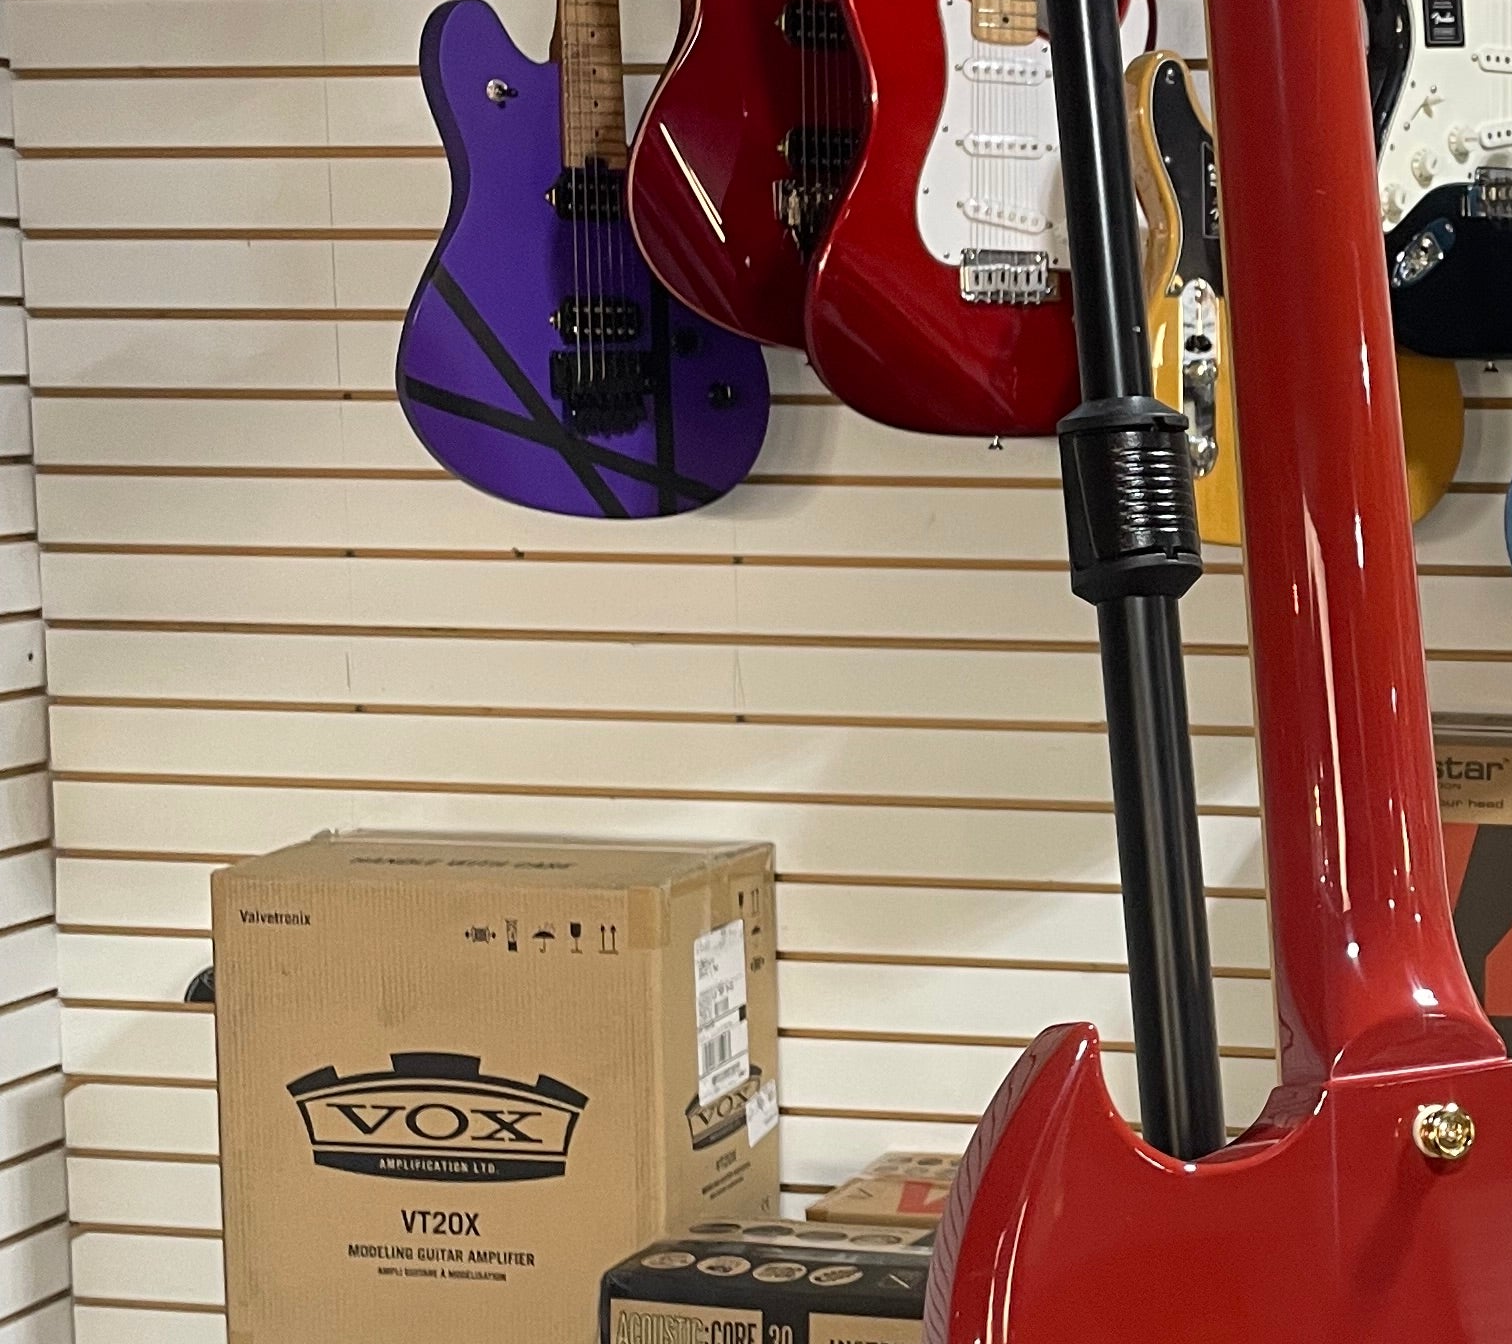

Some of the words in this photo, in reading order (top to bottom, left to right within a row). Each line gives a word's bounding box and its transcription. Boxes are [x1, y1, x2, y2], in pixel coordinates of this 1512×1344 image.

[239, 909, 311, 927] Valvetronix
[326, 1102, 543, 1144] VOX
[379, 1158, 469, 1174] AMPLIFICATION
[401, 1209, 481, 1237] VT20X
[348, 1244, 413, 1261] MODELING
[417, 1246, 464, 1264] GUITAR
[467, 1249, 535, 1267] AMPLIFIER
